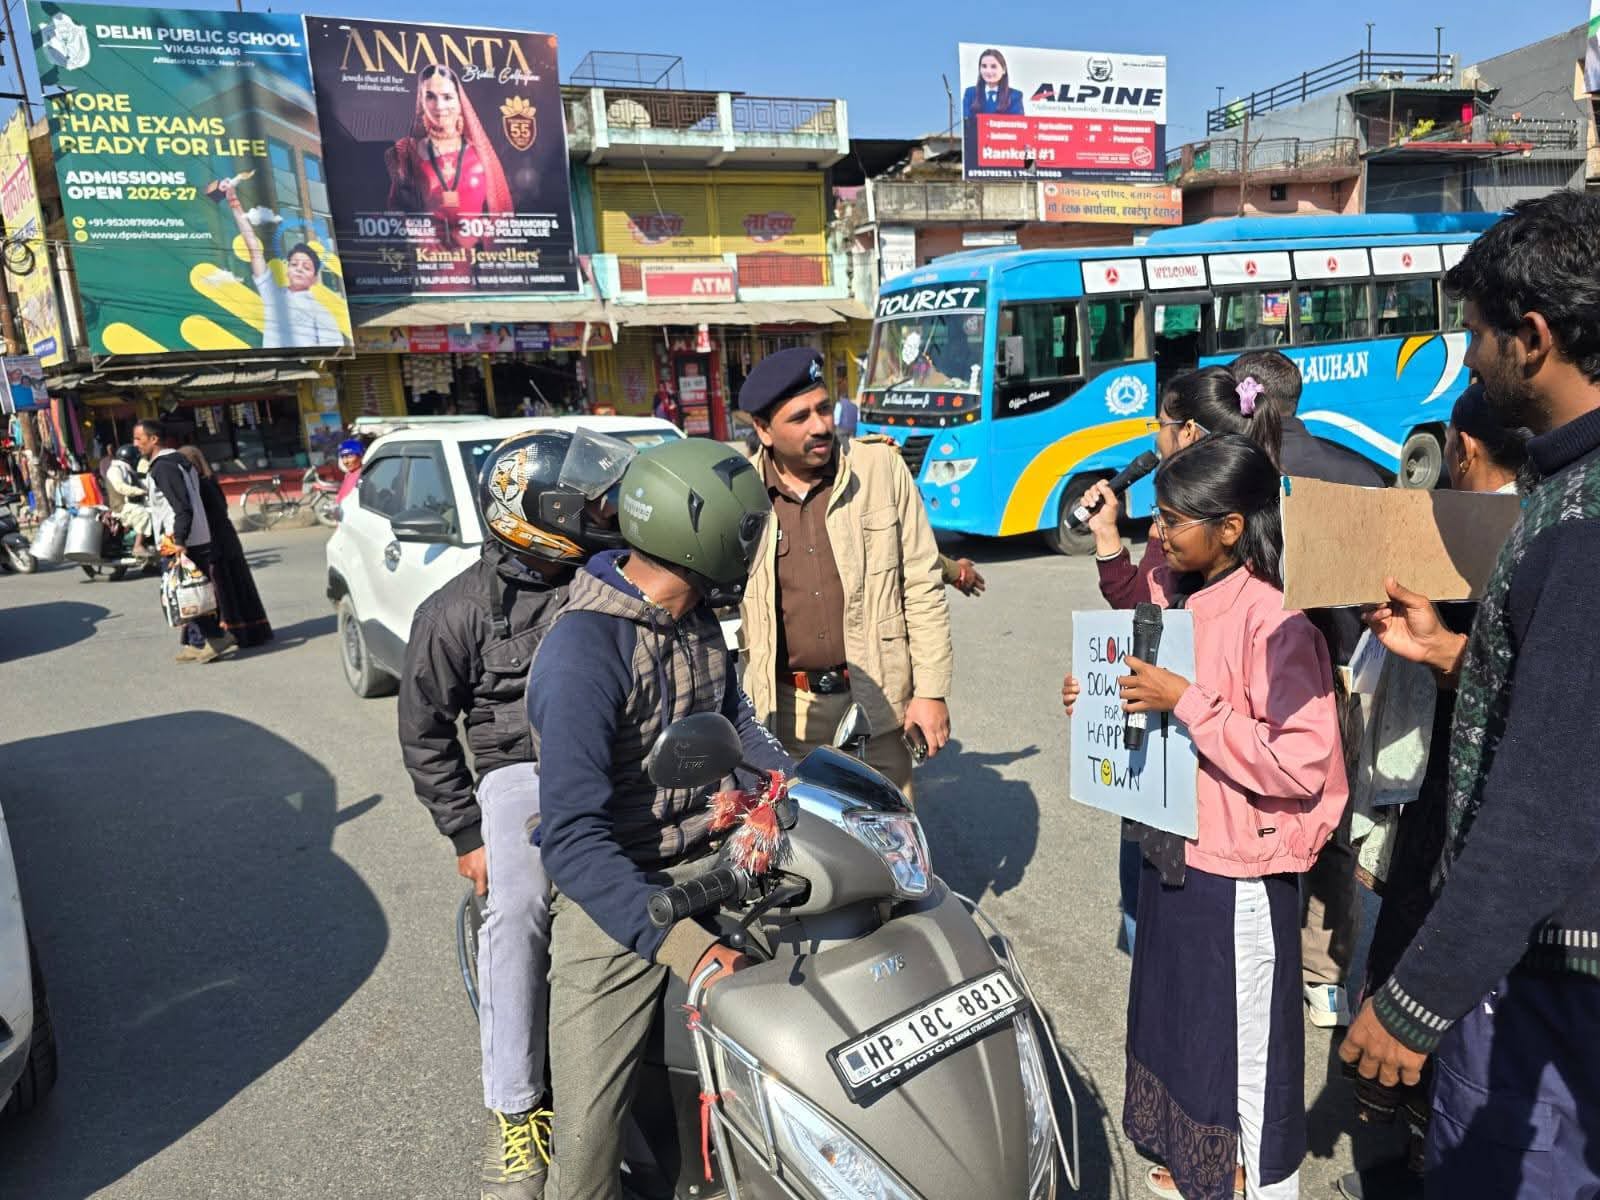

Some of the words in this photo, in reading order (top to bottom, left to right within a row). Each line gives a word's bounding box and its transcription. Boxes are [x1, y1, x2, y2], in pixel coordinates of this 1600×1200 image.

[96, 25, 152, 40] DELHI
[157, 28, 223, 43] PUBLIC
[228, 31, 300, 47] SCHOOL
[164, 44, 241, 56] VIKASNAGAR
[340, 27, 533, 74] ANANTA
[51, 93, 132, 112] MORE
[1030, 83, 1163, 106] ALPINE
[52, 114, 130, 133] THAN
[136, 116, 226, 135] EXAMS
[58, 135, 148, 154] READY
[156, 137, 208, 156] FOR
[216, 139, 268, 157] LIFE
[982, 147, 1037, 160] Ranked
[1038, 148, 1055, 160] #1
[65, 170, 186, 185] ADMISSIONS
[67, 186, 123, 200] OPEN
[127, 187, 197, 200] 2026-27
[90, 231, 212, 241] www.dpsvikasnagar.com
[355, 218, 407, 237] 100%
[458, 219, 496, 237] 30%
[416, 248, 466, 262] Kamal
[471, 248, 540, 264] Jewellers
[1153, 264, 1198, 279] WELCOME
[691, 277, 731, 294] ATM
[879, 288, 980, 316] TOURIST
[1089, 636, 1133, 664] SLOW
[1104, 705, 1119, 721] FOR
[1088, 755, 1143, 792] TOWN
[869, 954, 905, 982] TVS
[864, 1035, 894, 1069] HP
[908, 1007, 953, 1044] 18C
[958, 978, 1013, 1016] 8831
[871, 1068, 901, 1087] LEO
[904, 1039, 957, 1070] MOTOR
